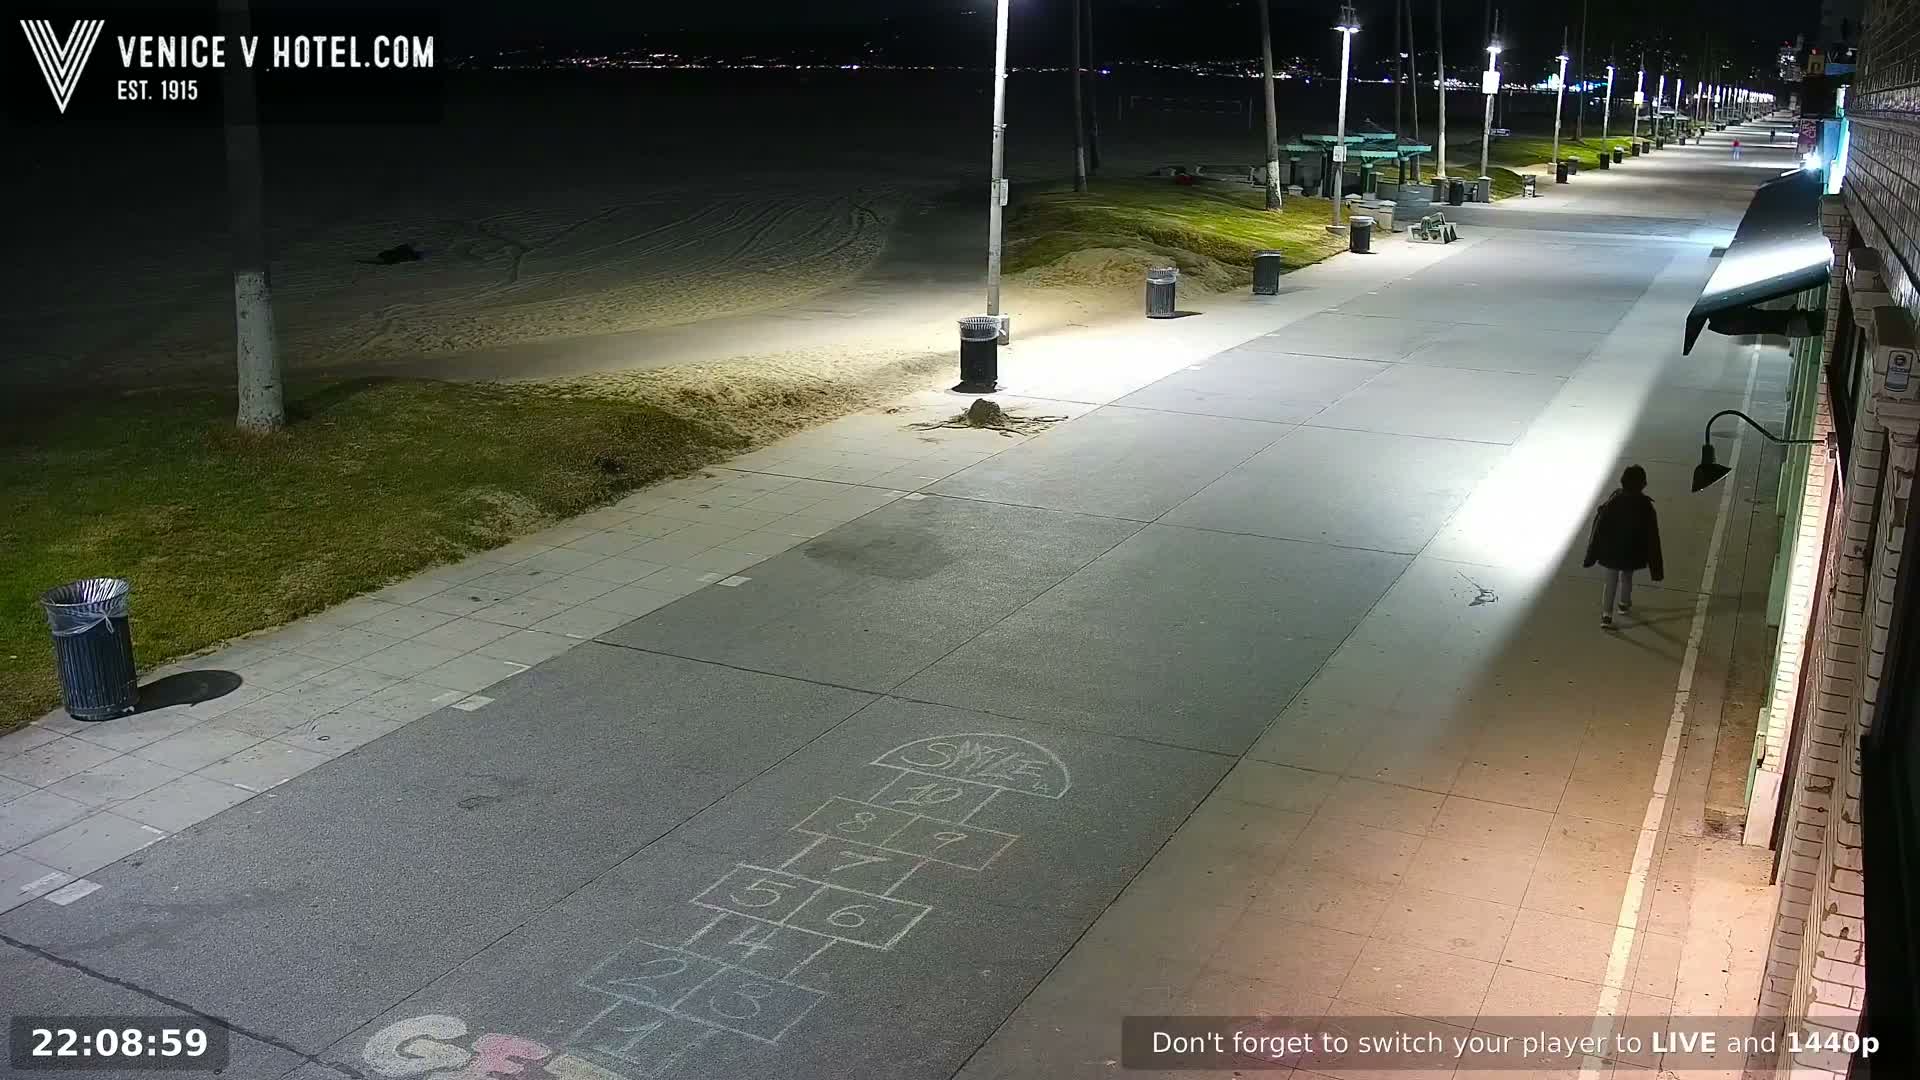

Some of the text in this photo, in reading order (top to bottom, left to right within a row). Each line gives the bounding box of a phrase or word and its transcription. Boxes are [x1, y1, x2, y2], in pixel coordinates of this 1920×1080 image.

[893, 783, 963, 806] 10
[836, 812, 876, 833] 8
[934, 832, 968, 850] 9
[831, 851, 890, 873] 7
[730, 879, 797, 907] 5
[826, 904, 880, 928] 6
[728, 924, 782, 960] 4
[607, 958, 687, 998] 2
[709, 984, 773, 1019] 3
